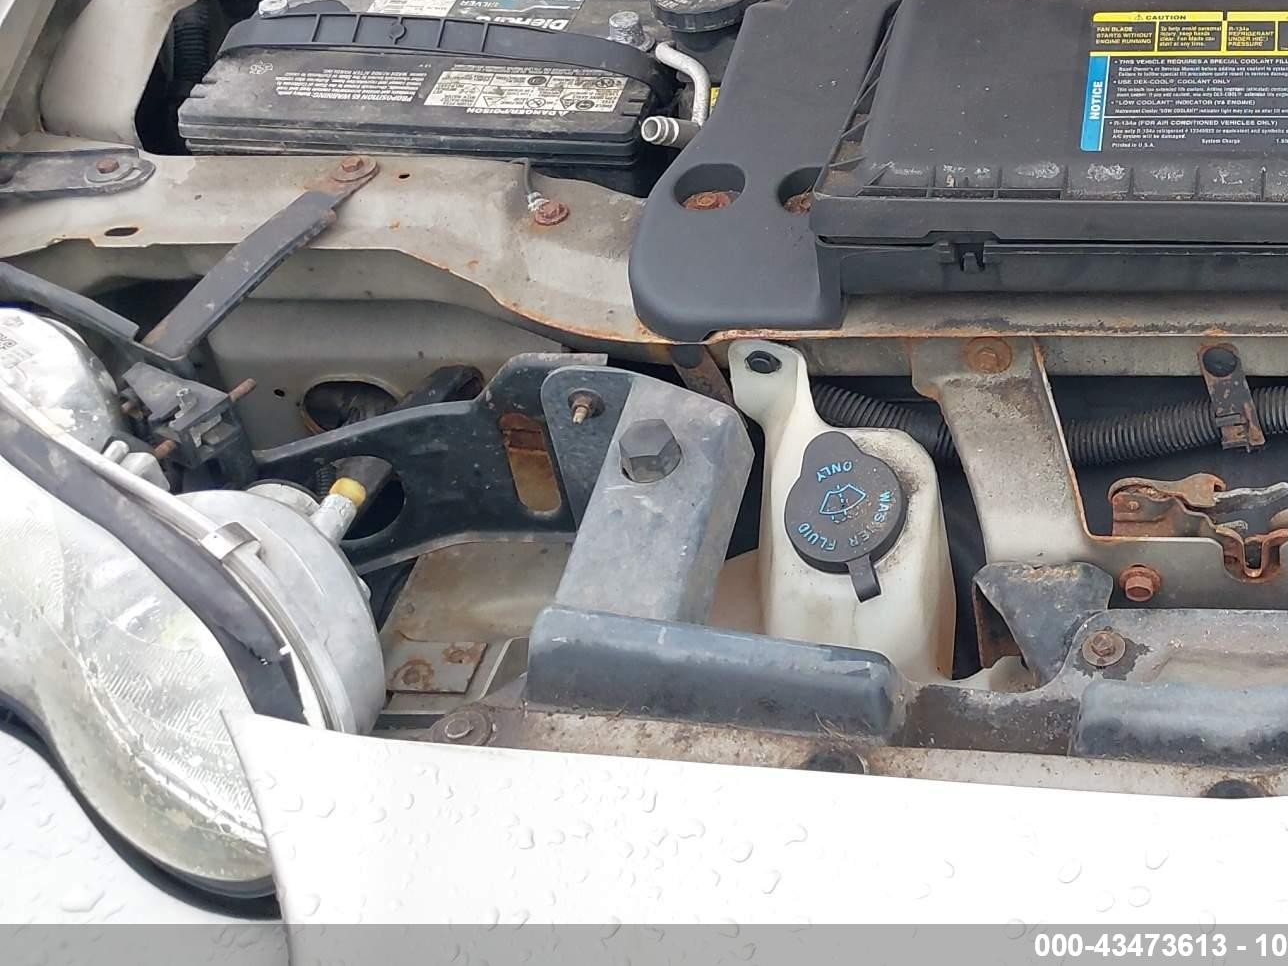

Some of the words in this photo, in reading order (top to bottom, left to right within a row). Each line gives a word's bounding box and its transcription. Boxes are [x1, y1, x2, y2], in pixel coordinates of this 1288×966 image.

[466, 107, 556, 115] DANGER/POISON
[1089, 81, 1104, 120] NOTICE
[816, 460, 854, 482] ONLY
[797, 523, 837, 551] FLUID
